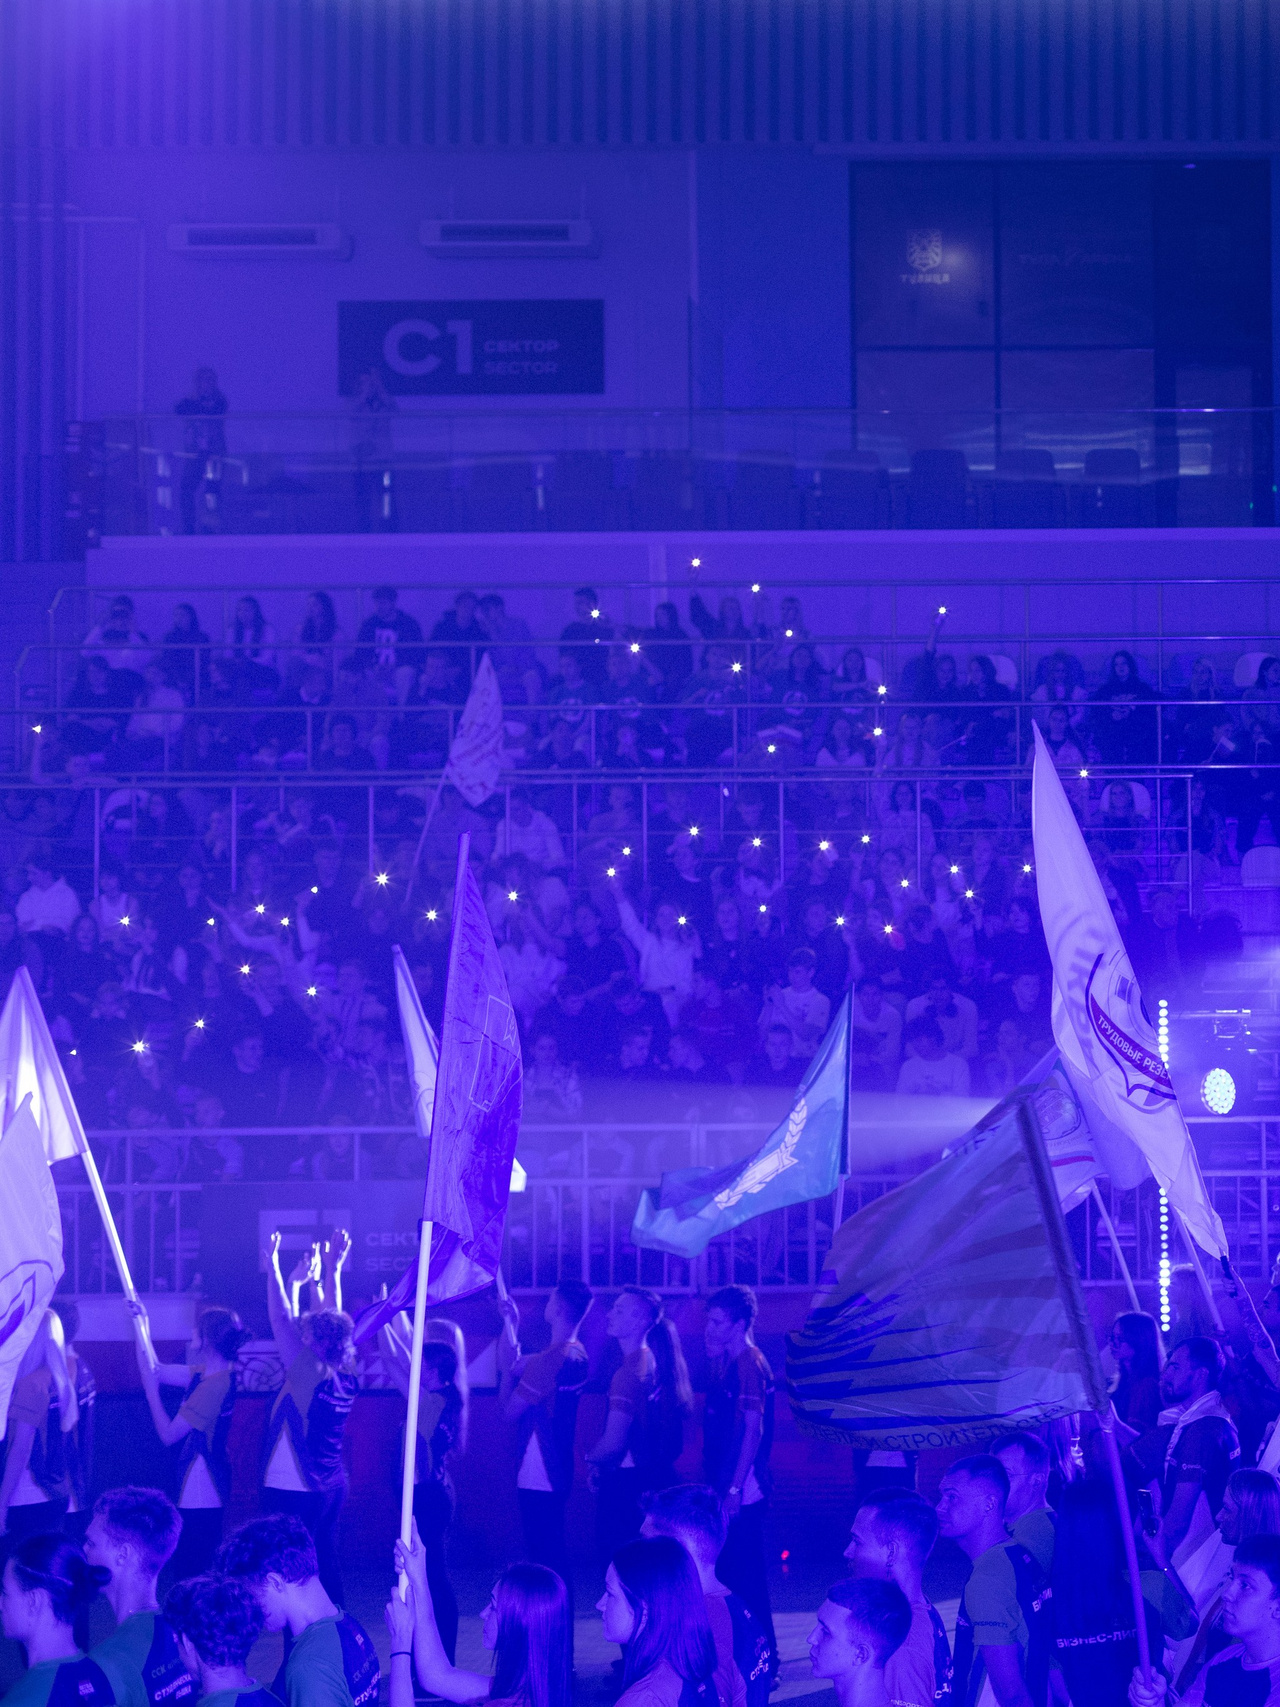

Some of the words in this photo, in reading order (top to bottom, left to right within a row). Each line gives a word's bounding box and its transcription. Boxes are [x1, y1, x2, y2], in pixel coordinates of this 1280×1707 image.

[483, 339, 559, 354] СЕКТОР
[483, 361, 558, 376] SECTOR
[1098, 1014, 1143, 1064] ТРУДОВЫЕ
